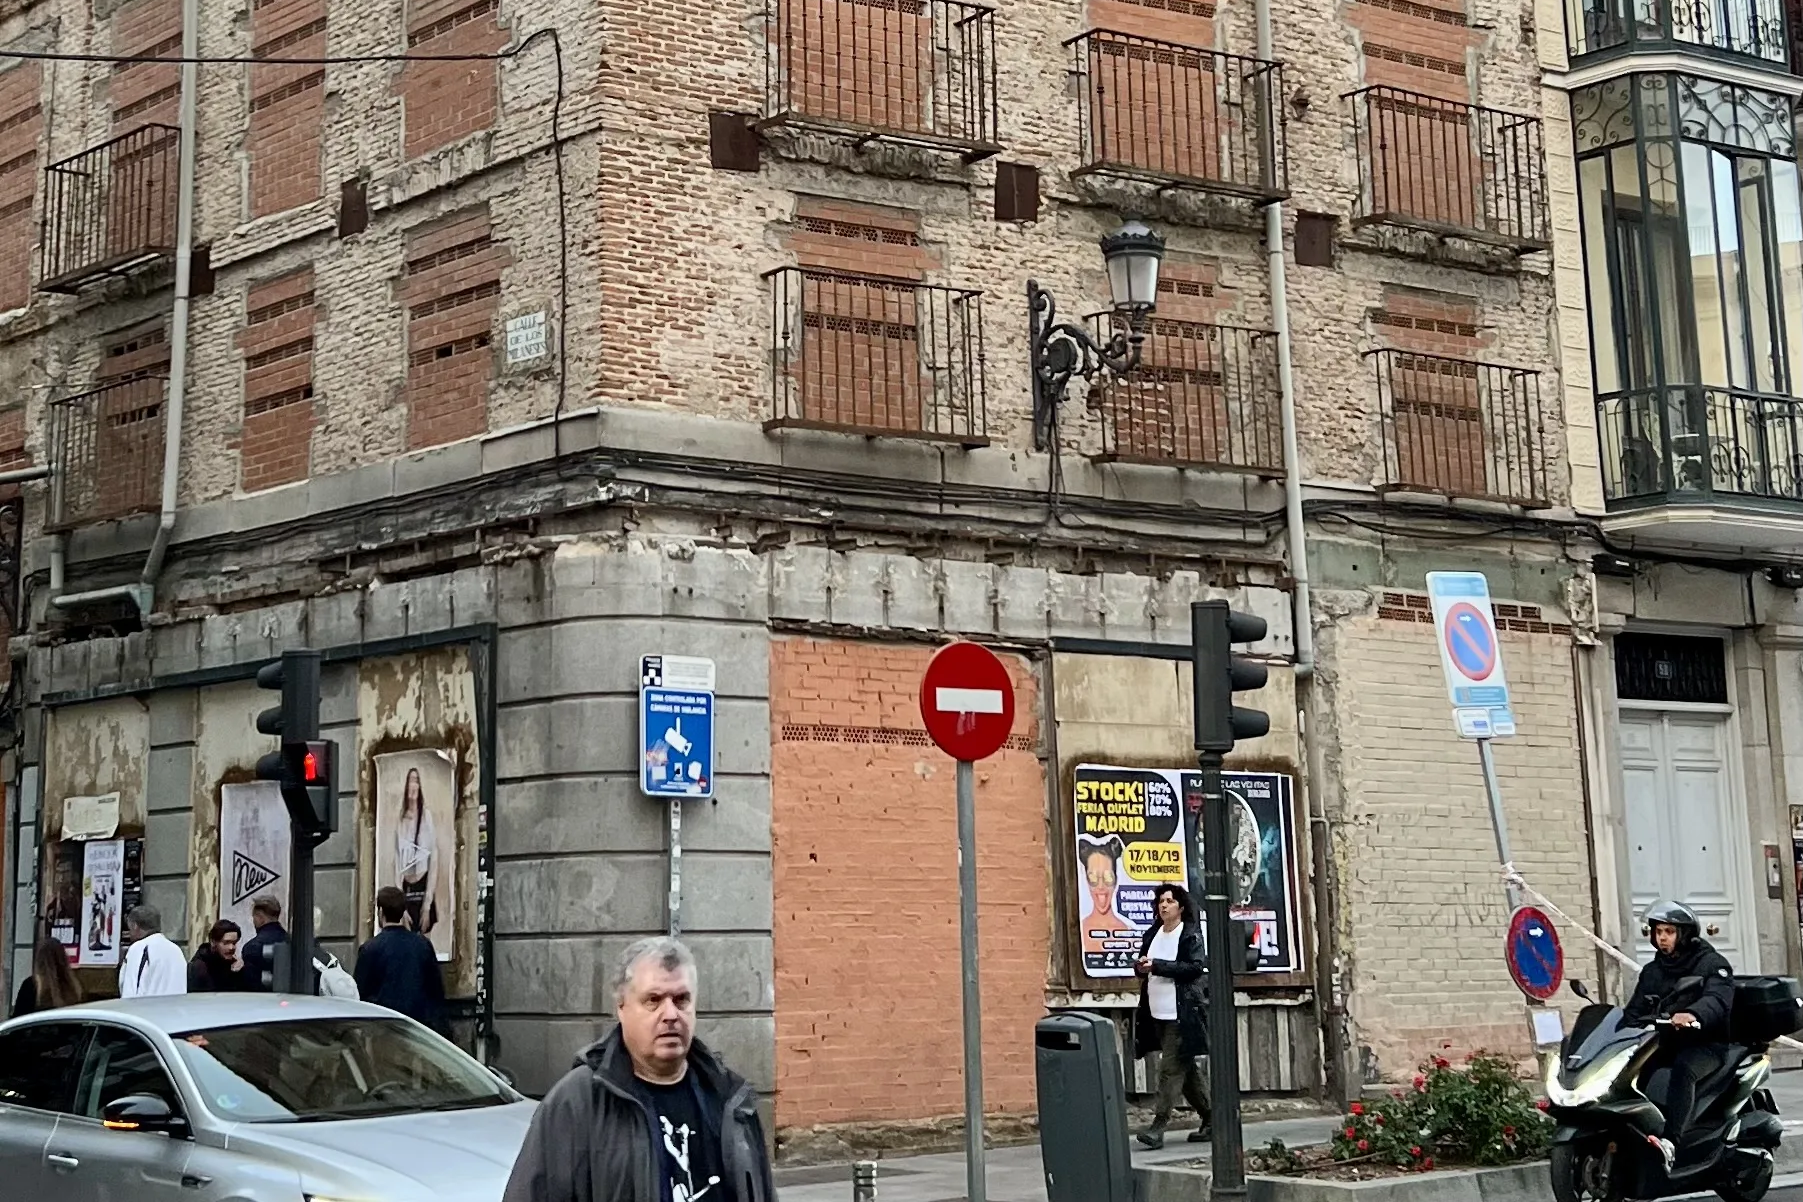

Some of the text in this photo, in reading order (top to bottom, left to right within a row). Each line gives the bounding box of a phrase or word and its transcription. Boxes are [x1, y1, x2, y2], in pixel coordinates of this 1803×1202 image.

[515, 315, 537, 331] CALLE
[510, 330, 543, 345] DE LOS
[1076, 781, 1144, 802] STOCK!
[1149, 794, 1172, 805] 70%
[1077, 801, 1144, 815] FERIA OUTLET
[1085, 815, 1146, 833] MADRID
[1128, 849, 1180, 863] 17/18/19
[1130, 864, 1181, 874] NOVIEMBRE
